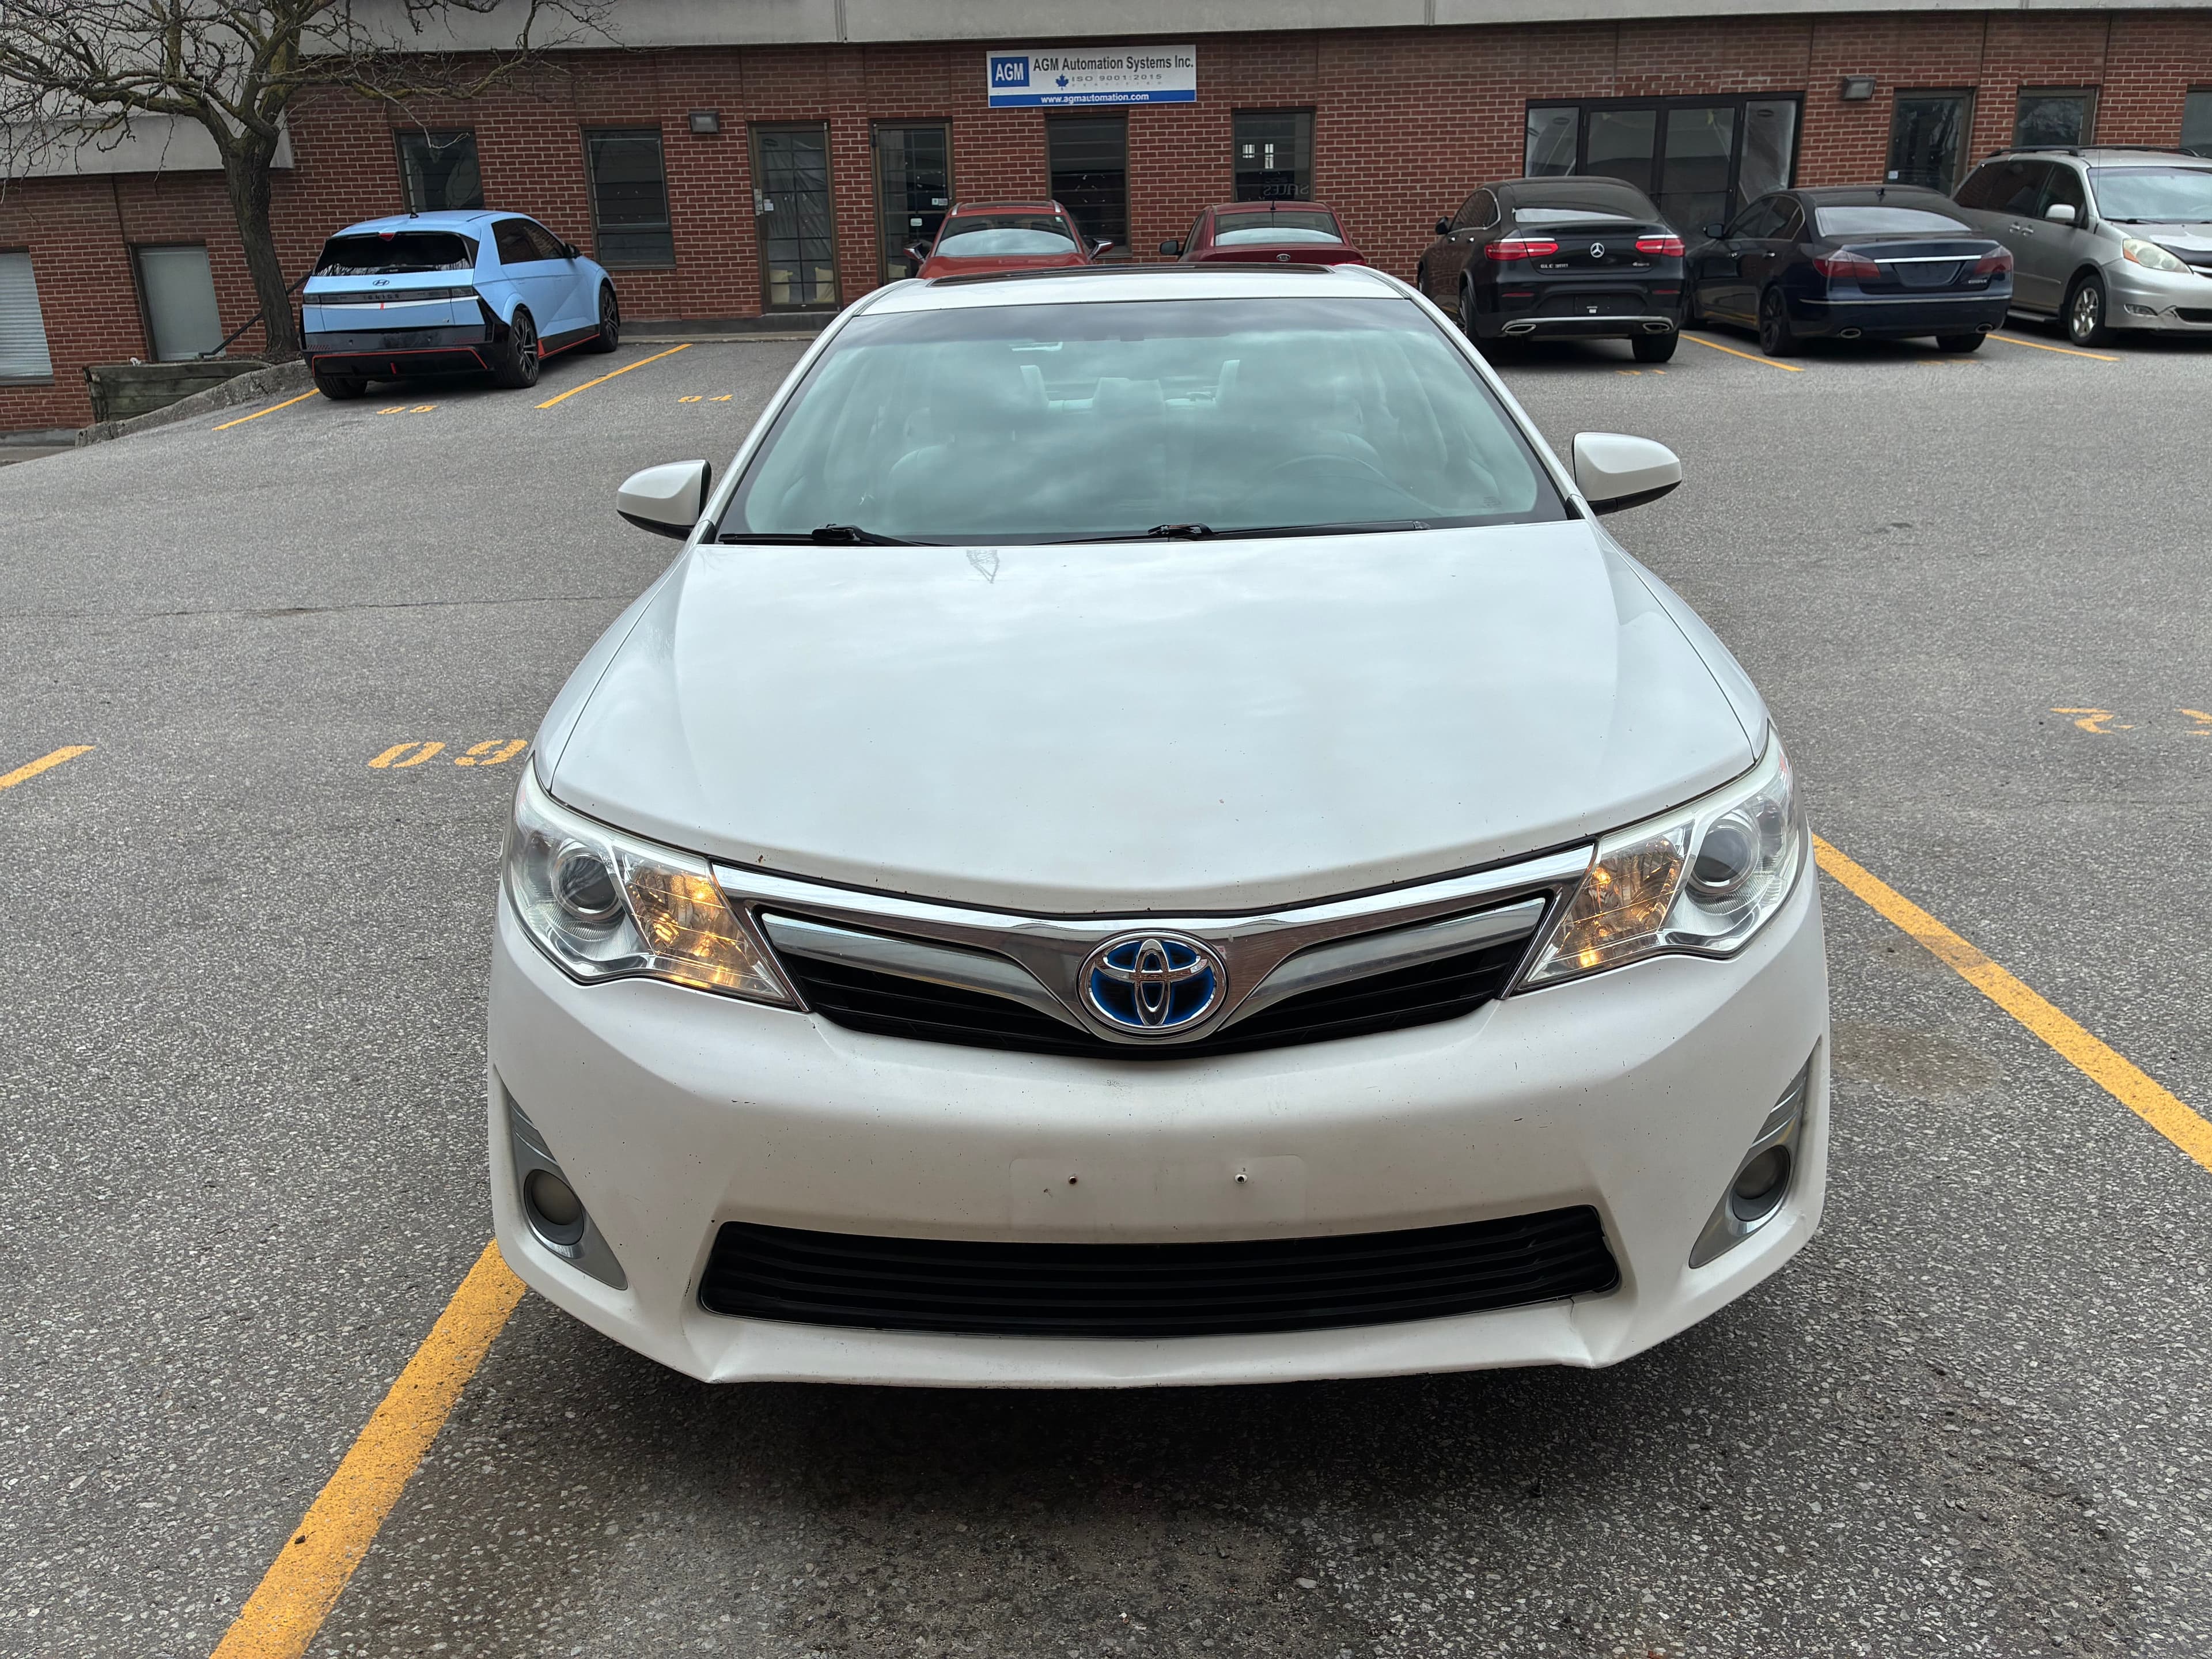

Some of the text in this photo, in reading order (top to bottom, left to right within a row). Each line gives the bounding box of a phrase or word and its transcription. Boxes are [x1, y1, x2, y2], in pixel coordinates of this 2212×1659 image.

[995, 63, 1024, 81] AGM
[1033, 55, 1194, 73] AGM Automation Systems Inc.
[1040, 93, 1149, 104] www.agmautomation.com
[368, 739, 528, 768] 09
